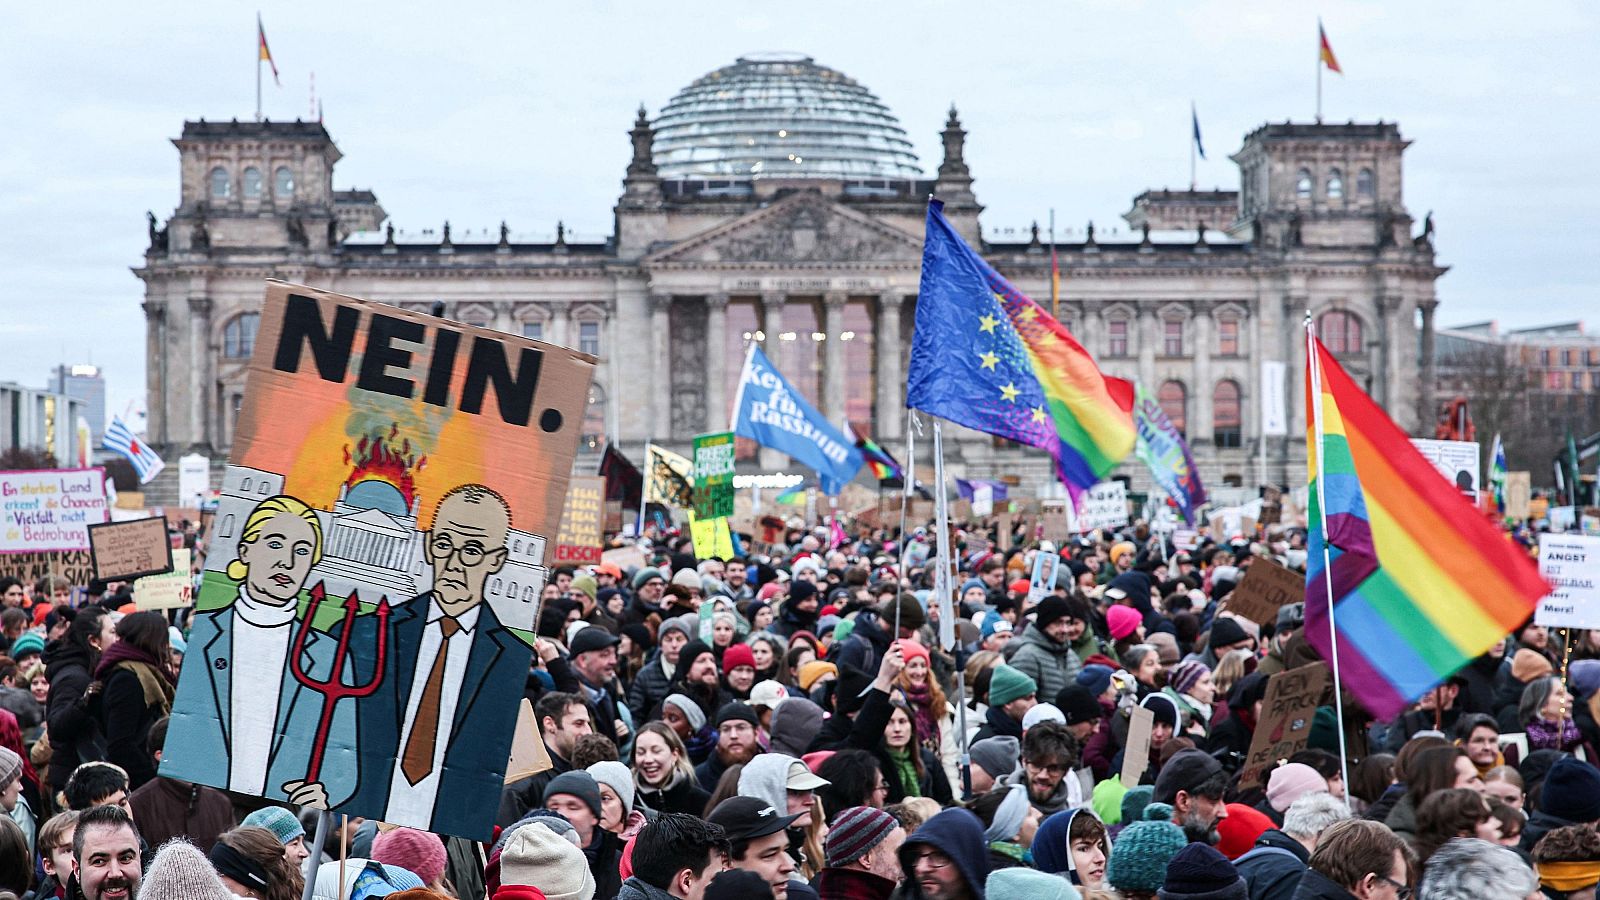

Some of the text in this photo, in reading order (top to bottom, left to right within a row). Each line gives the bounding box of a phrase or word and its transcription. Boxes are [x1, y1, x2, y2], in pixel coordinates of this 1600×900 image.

[274, 294, 563, 433] NEIN.
[3, 478, 92, 496] Ein starkes Land
[5, 498, 40, 510] erkennt
[61, 495, 105, 509] Chancen
[6, 512, 14, 523] in
[61, 510, 86, 522] nicht
[24, 526, 85, 545] Bedrohung
[61, 550, 91, 566] RAS
[1544, 604, 1574, 614] Merz!
